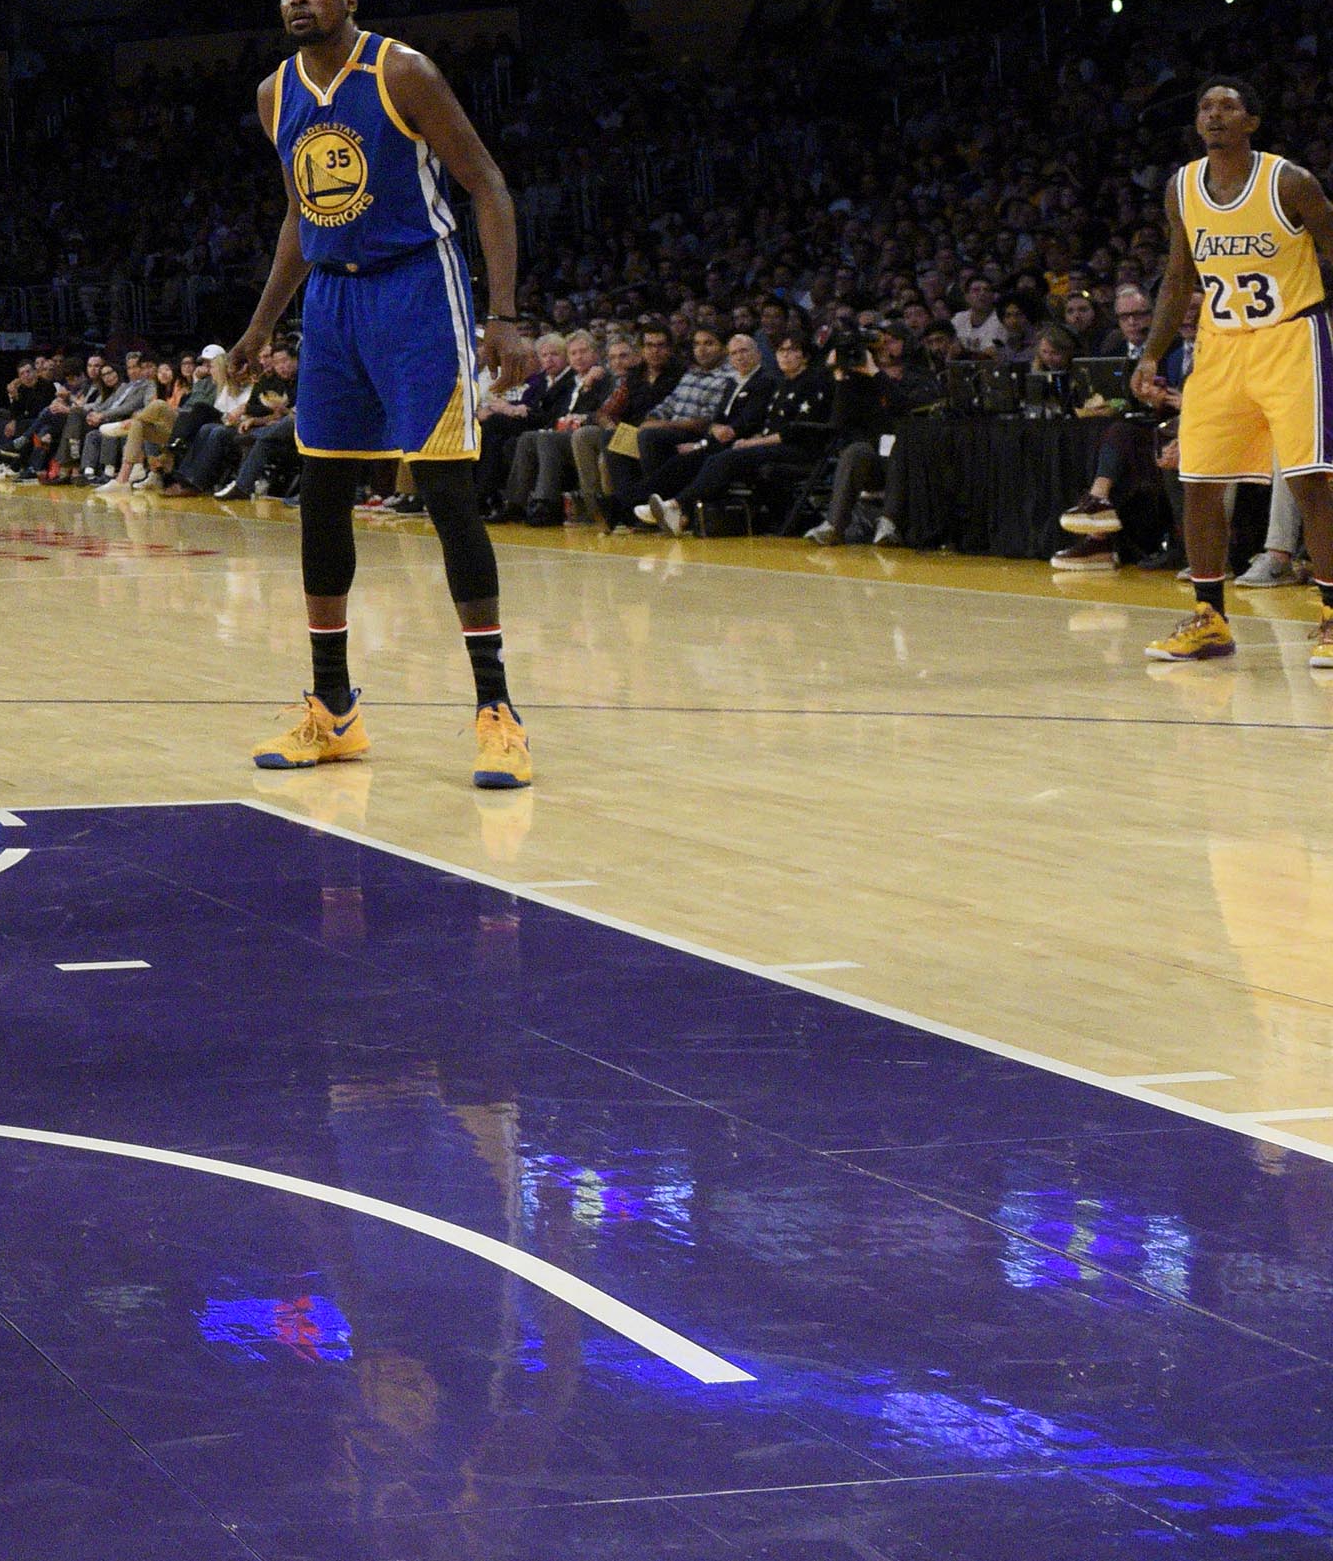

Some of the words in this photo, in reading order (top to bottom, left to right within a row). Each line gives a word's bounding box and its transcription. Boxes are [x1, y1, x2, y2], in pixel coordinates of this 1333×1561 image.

[292, 122, 332, 154] GOLDEN
[333, 122, 365, 146] STATE
[325, 147, 352, 171] 35
[299, 192, 375, 228] WARRIORS
[1193, 227, 1281, 263] LAKERS
[1201, 271, 1284, 329] 23
